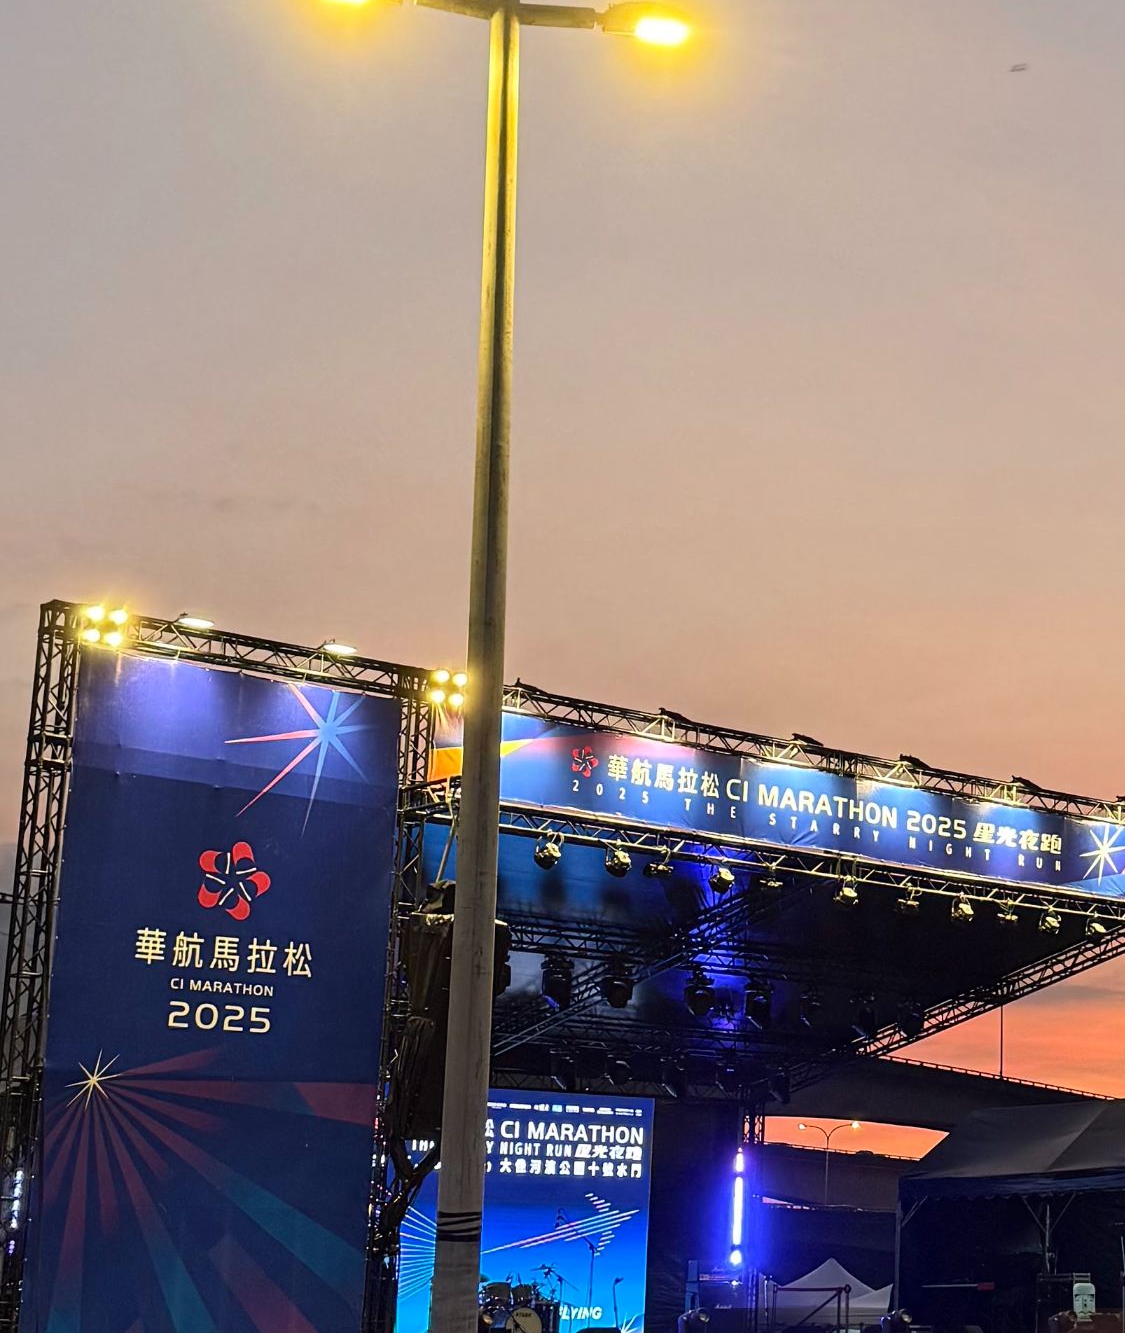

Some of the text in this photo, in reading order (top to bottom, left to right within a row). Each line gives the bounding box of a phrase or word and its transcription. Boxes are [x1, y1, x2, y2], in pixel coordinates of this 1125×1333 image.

[607, 754, 1062, 855] 華航馬拉松 CI MARATHON 2025 星光夜跑
[572, 779, 1062, 872] 2025 THE STARRY NIGHT RUN
[134, 927, 313, 978] 華航馬拉松
[170, 977, 274, 997] CI MARATHON
[167, 1000, 271, 1034] 2025
[500, 1120, 520, 1139] CI
[527, 1121, 644, 1145] MARATHON
[500, 1141, 541, 1157] NIGHT
[546, 1143, 572, 1158] RUN
